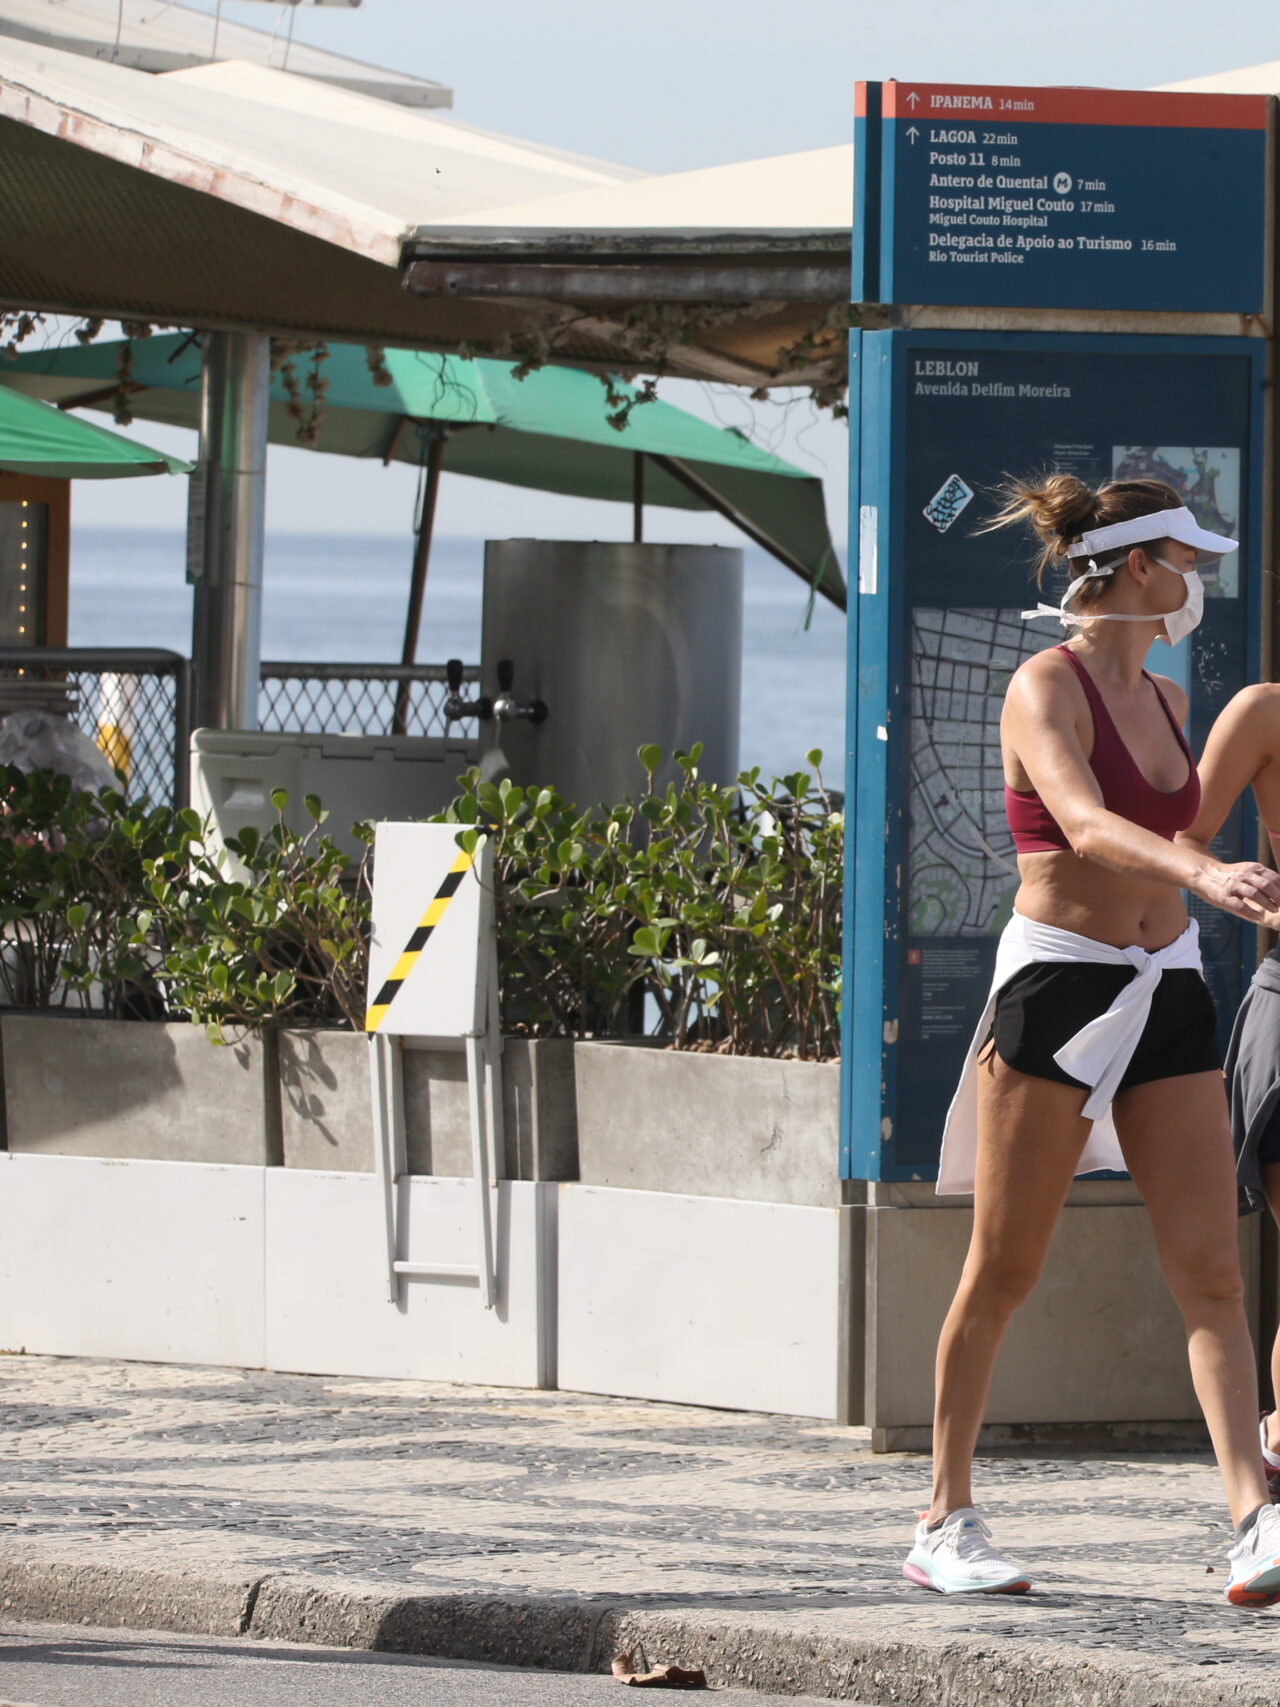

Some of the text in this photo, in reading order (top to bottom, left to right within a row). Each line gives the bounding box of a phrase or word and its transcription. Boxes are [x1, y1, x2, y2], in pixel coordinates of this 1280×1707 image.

[930, 95, 993, 110] IPANEMA
[930, 130, 976, 143] LAGOA
[929, 152, 966, 166] Posto
[969, 153, 985, 166] 11
[929, 174, 974, 188] Antero
[977, 174, 993, 188] de
[996, 175, 1048, 189] Quental
[929, 196, 984, 211] Hospital
[988, 197, 1033, 213] Miguel
[1036, 198, 1074, 212] Couto
[929, 213, 1048, 228] Miguel Couto Hospital
[929, 233, 994, 249] Delegacia
[997, 234, 1013, 248] de
[1017, 235, 1054, 251] Apoio
[1058, 238, 1074, 249] ao
[1077, 236, 1132, 250] Turismo
[929, 251, 1024, 264] Rio Tourist Police
[915, 361, 979, 376] LEBLON
[914, 382, 1071, 398] Avenida Delfim Moreira
